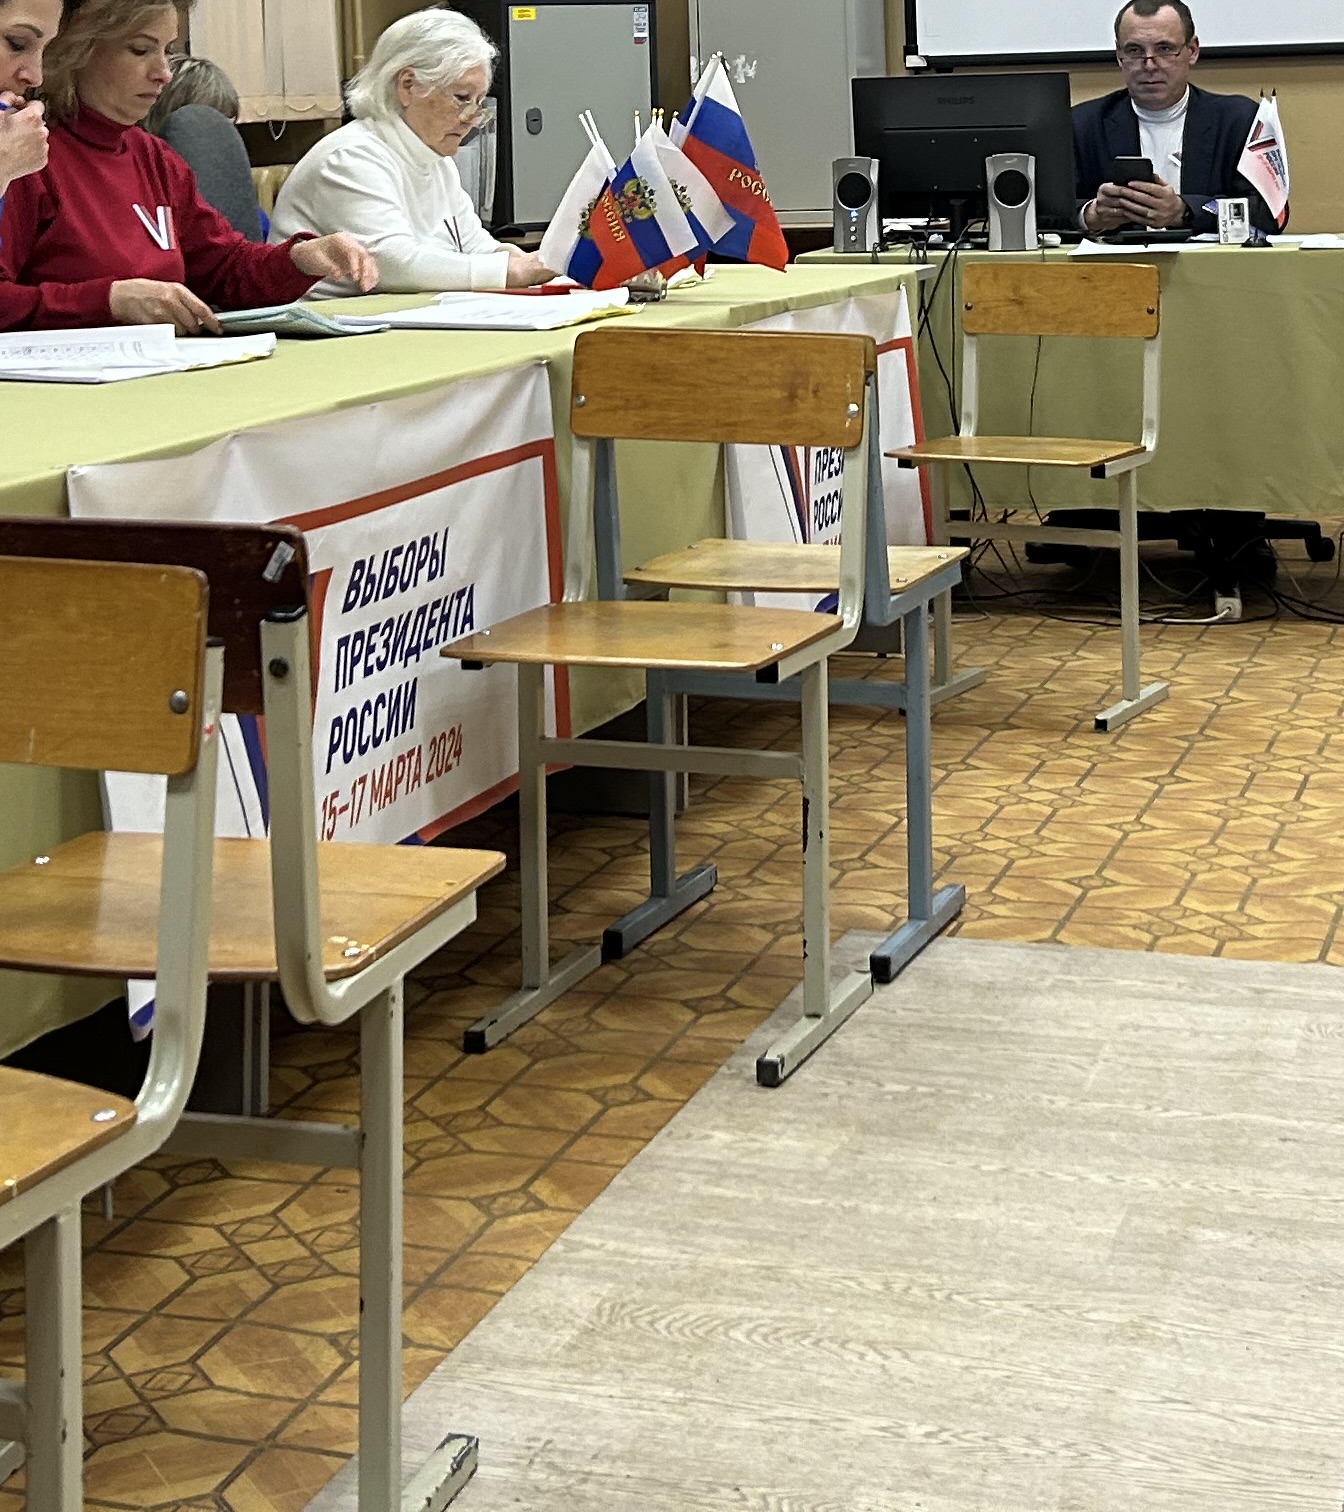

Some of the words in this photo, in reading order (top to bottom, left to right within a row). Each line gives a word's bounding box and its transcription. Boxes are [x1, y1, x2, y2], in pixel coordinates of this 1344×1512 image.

[342, 526, 449, 615] ВЫБОРЫ
[334, 583, 475, 694] ПРЕЗИДЕНТА
[325, 676, 418, 775] РОССИИ
[368, 744, 423, 817] МАРТА
[425, 723, 463, 784] 2024
